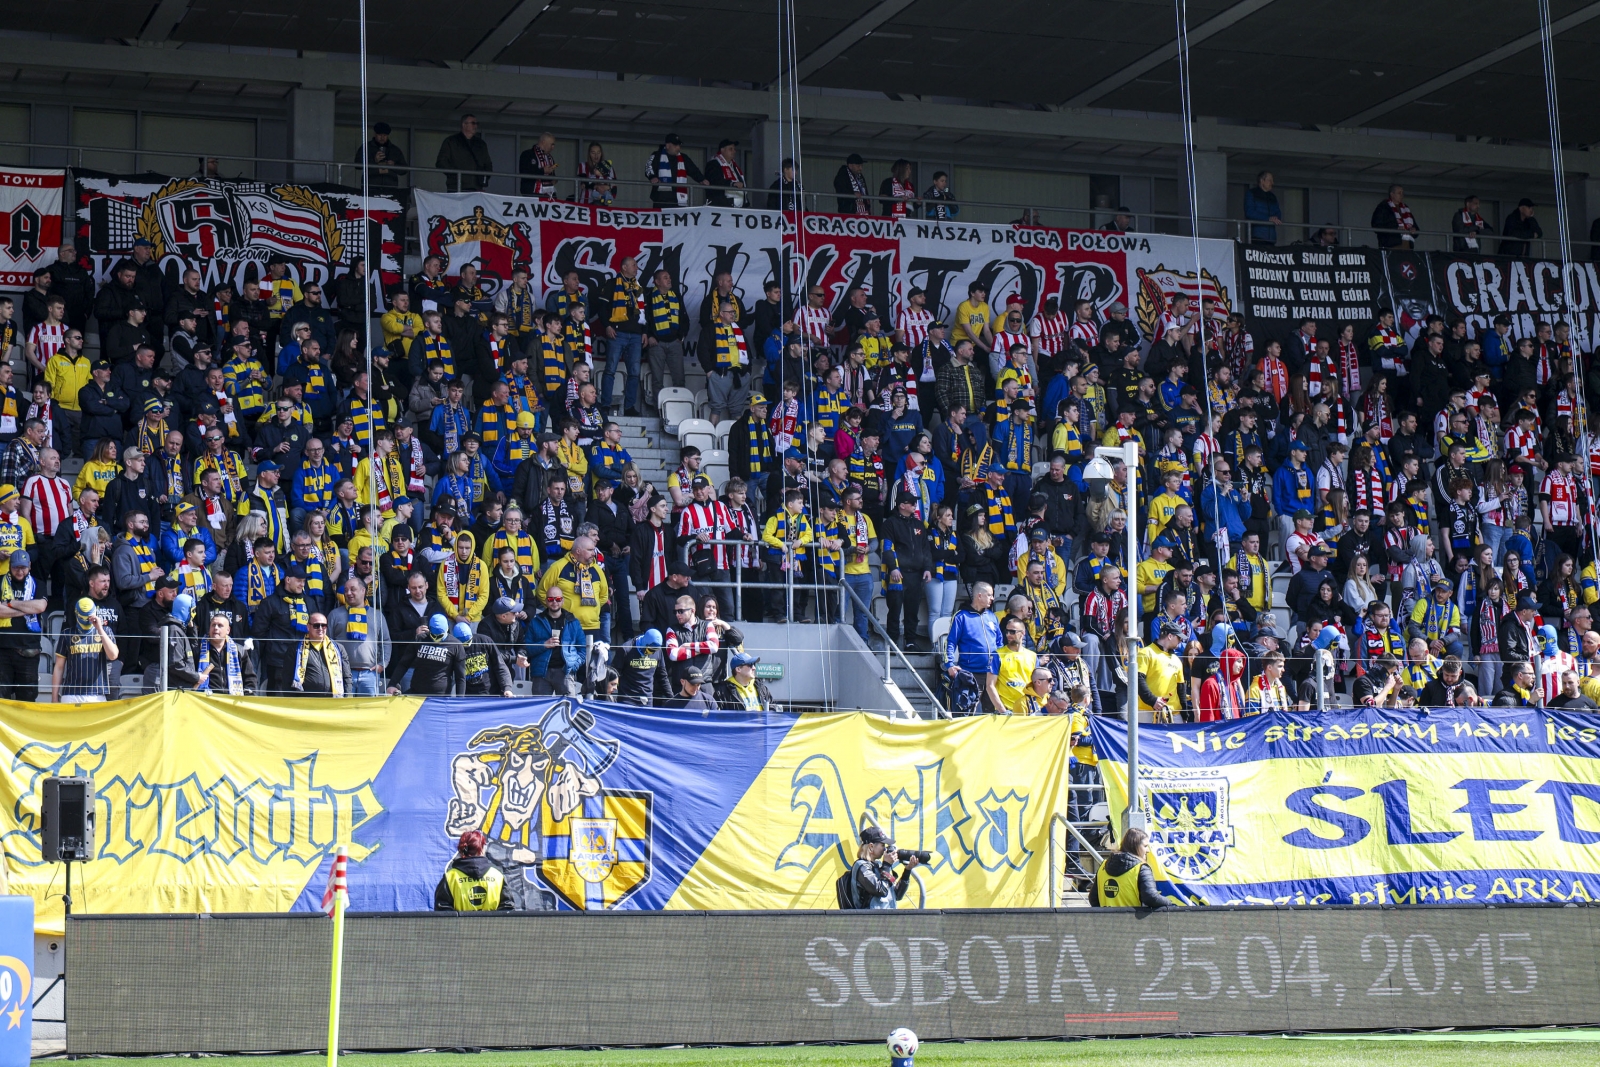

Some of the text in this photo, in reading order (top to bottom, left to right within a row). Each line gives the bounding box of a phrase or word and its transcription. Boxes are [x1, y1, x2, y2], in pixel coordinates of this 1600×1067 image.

[250, 202, 269, 214] KS
[502, 201, 589, 222] ZAWSZE
[600, 208, 701, 227] BĘDZIEMY
[711, 212, 722, 227] Z
[805, 216, 906, 238] CRACOVIA
[917, 224, 982, 244] NASZĄ
[991, 229, 1061, 249] DRUGĄ
[1070, 233, 1152, 254] POŁOWĄ
[257, 225, 319, 248] CRACOVIA
[215, 248, 270, 262] CRACOVIA
[1302, 252, 1334, 266] SMOK
[1338, 254, 1366, 266] RUDY
[1157, 276, 1175, 287] KS
[1248, 267, 1371, 284] DROBNY DZIURA FAJTER
[1250, 285, 1371, 302] FIGURKA GŁOWA GÓRA
[1252, 304, 1373, 320] GUMIŚ KAFARA KOBRA
[446, 561, 456, 596] CRACOVIA
[1165, 717, 1600, 754] Nie straszny nam jes
[1149, 830, 1225, 844] ARKA
[577, 853, 610, 861] ARKA
[1155, 847, 1221, 876] GDYNIA
[805, 932, 1540, 1012] SOBOTA, 25.04, 20:15
